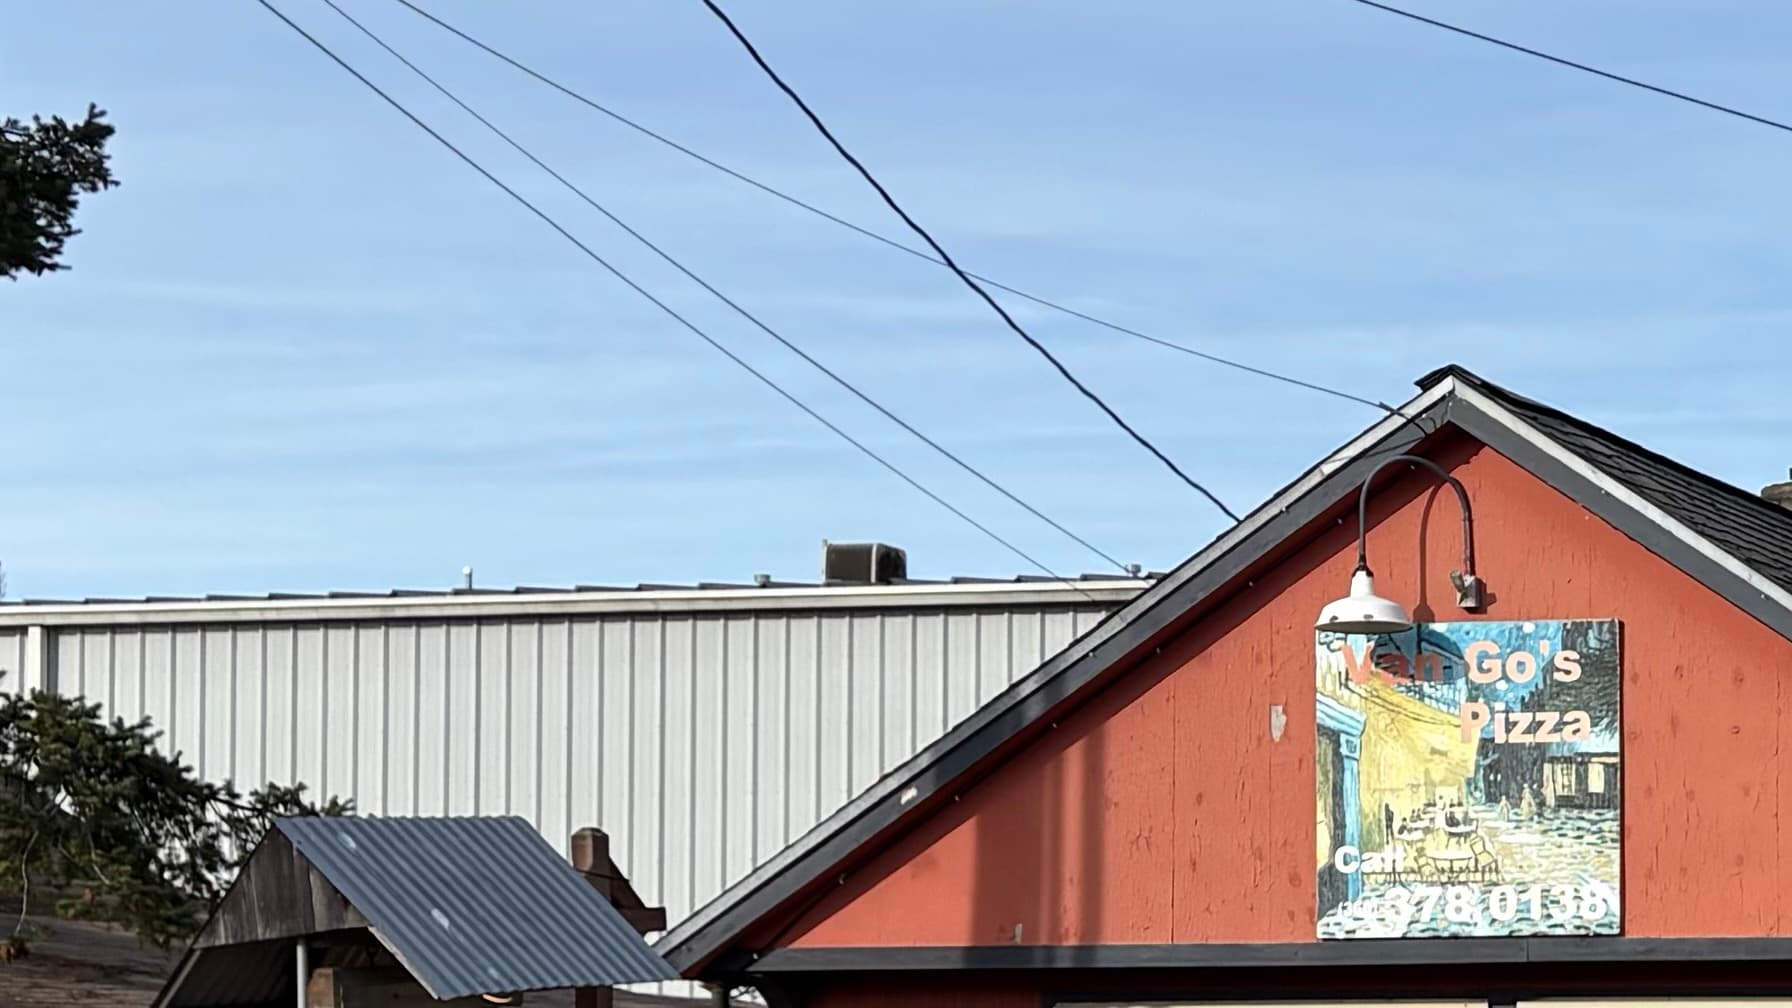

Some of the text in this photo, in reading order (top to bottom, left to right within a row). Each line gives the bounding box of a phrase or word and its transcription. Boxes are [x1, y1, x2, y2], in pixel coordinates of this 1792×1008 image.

[1340, 640, 1583, 686] Van Go's
[1459, 702, 1592, 744] Pizza
